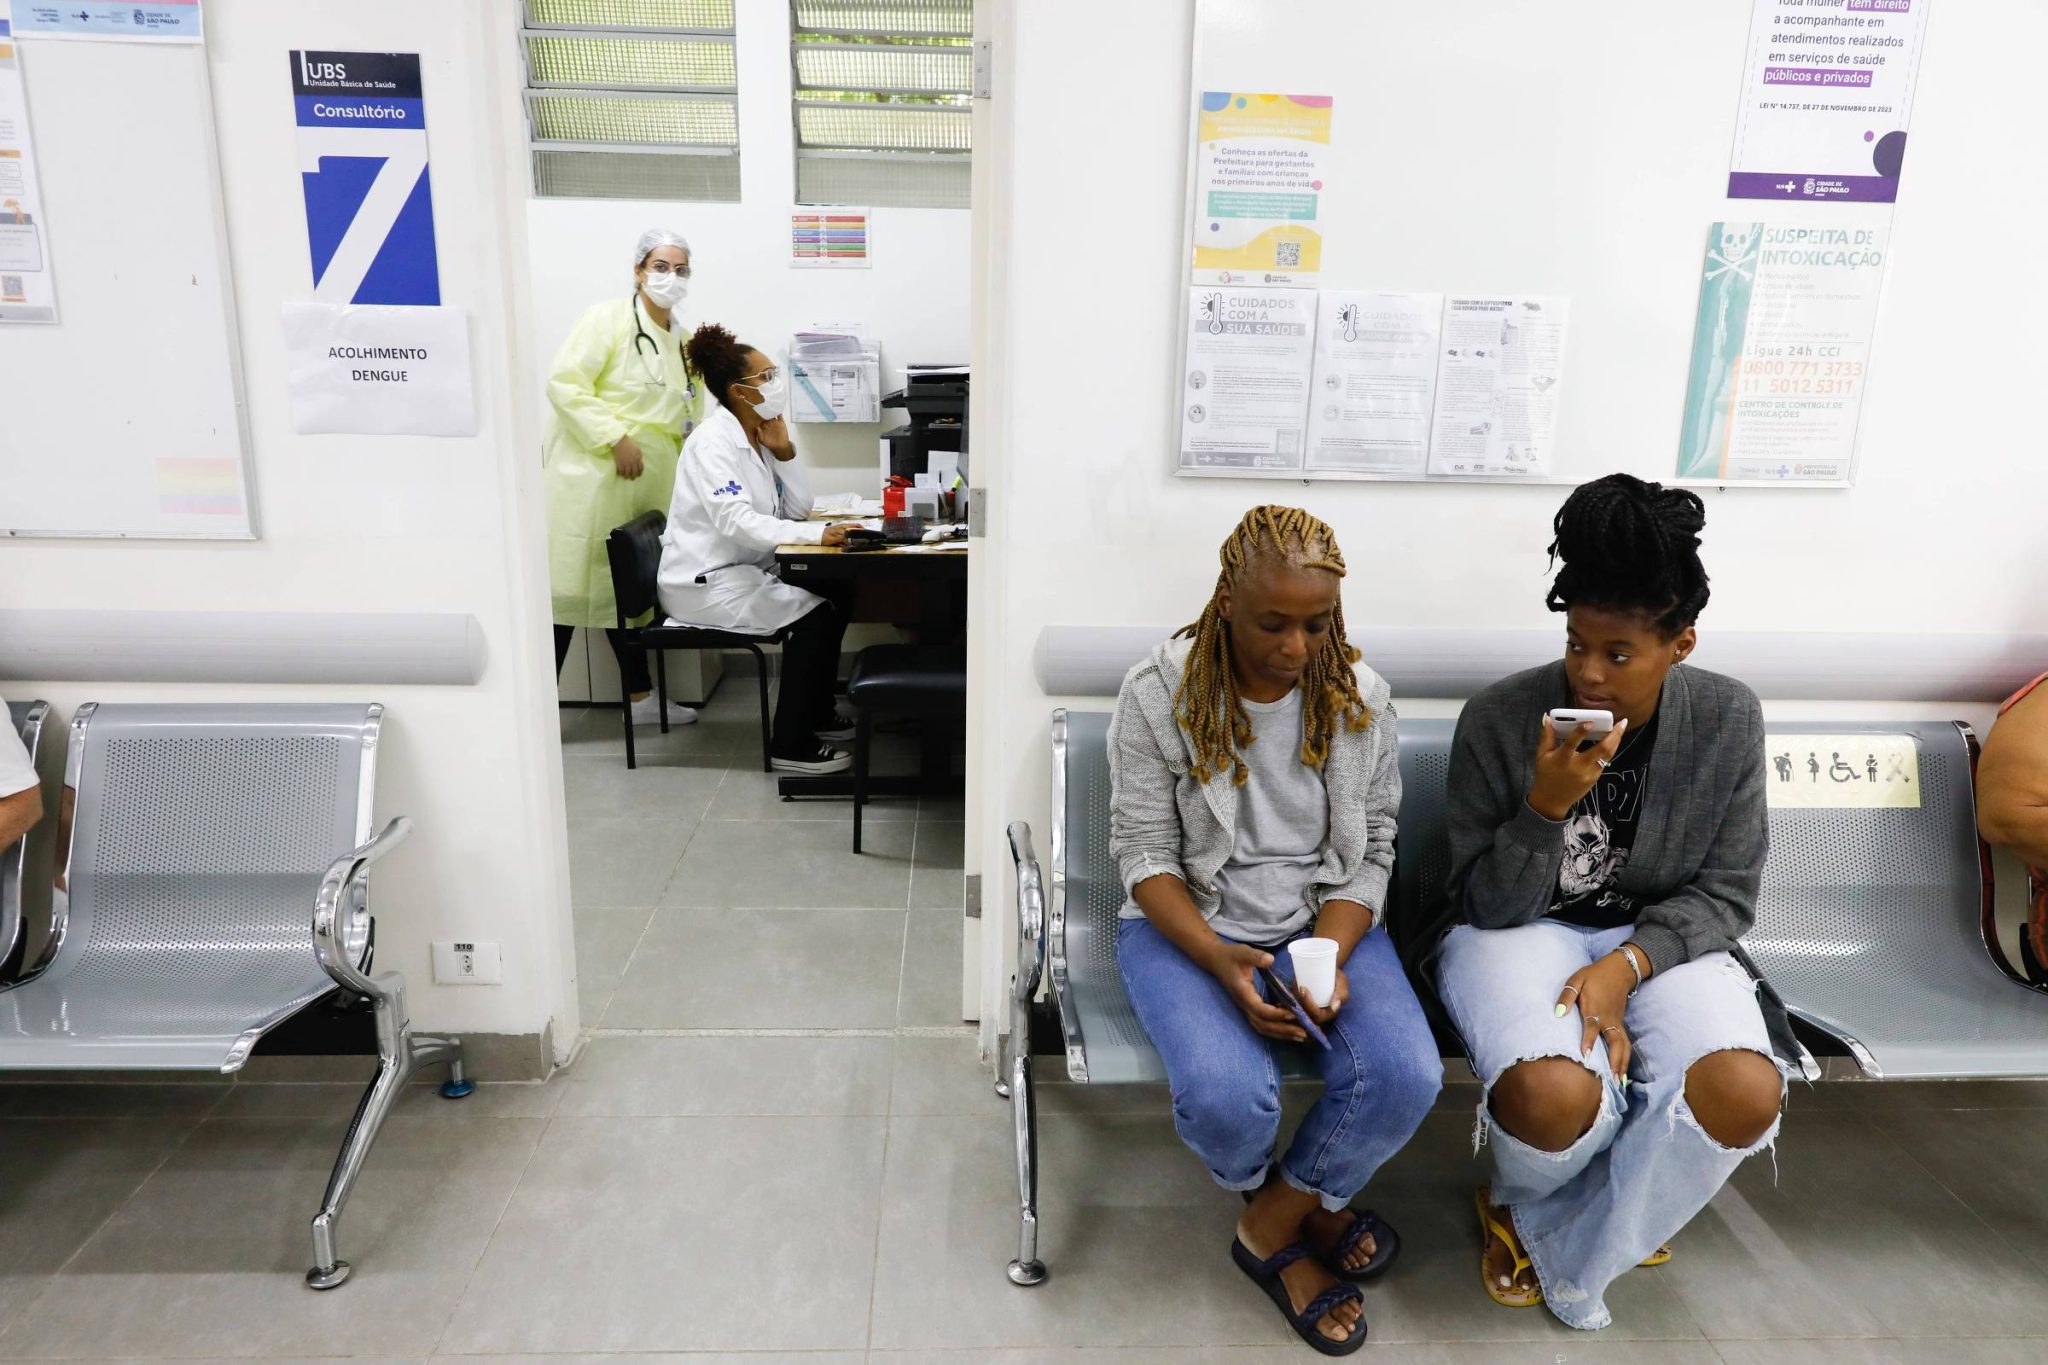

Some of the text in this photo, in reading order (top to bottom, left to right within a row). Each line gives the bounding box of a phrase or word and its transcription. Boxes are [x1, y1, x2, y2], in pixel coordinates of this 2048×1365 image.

[1850, 0, 1871, 8] tem
[1873, 0, 1909, 9] direito
[1774, 15, 1885, 28] a acompanhante em
[1771, 33, 1905, 48] atendimentos realizados
[1768, 52, 1886, 66] em serviços de saúde
[308, 62, 346, 80] UBS
[1765, 69, 1870, 85] públicos e privados
[340, 79, 363, 88] Básica
[364, 80, 373, 88] de
[374, 81, 397, 89] Saúde
[313, 103, 406, 119] Consultório
[1221, 147, 1256, 157] Conheça
[1268, 149, 1298, 157] ofertas
[1298, 150, 1309, 158] da
[1213, 157, 1315, 168] Prefeitura para gestantes
[1275, 169, 1309, 179] crianças
[1227, 179, 1264, 187] primeiros
[297, 126, 428, 305] 7
[1766, 228, 1874, 246] SUSPEITA DE
[1761, 247, 1882, 270] INTOXICAÇÃO
[1229, 297, 1297, 309] CUIDADOS
[1228, 310, 1269, 320] COM A
[1363, 311, 1425, 321] CUIDADO
[1227, 321, 1299, 335] SUA SAÚDE
[328, 346, 427, 360] ACOLHIMENTO
[1747, 344, 1841, 358] Ligue 24h CCI
[1743, 360, 1863, 377] 0800 771 3733
[352, 369, 408, 382] DENGUE
[1769, 378, 1811, 393] 5012
[1815, 379, 1853, 394] 5311
[1738, 400, 1773, 408] CENTRO
[1774, 401, 1786, 409] DE
[1788, 401, 1830, 409] CONTROLE
[1737, 409, 1800, 420] INTOXICAÇÕES
